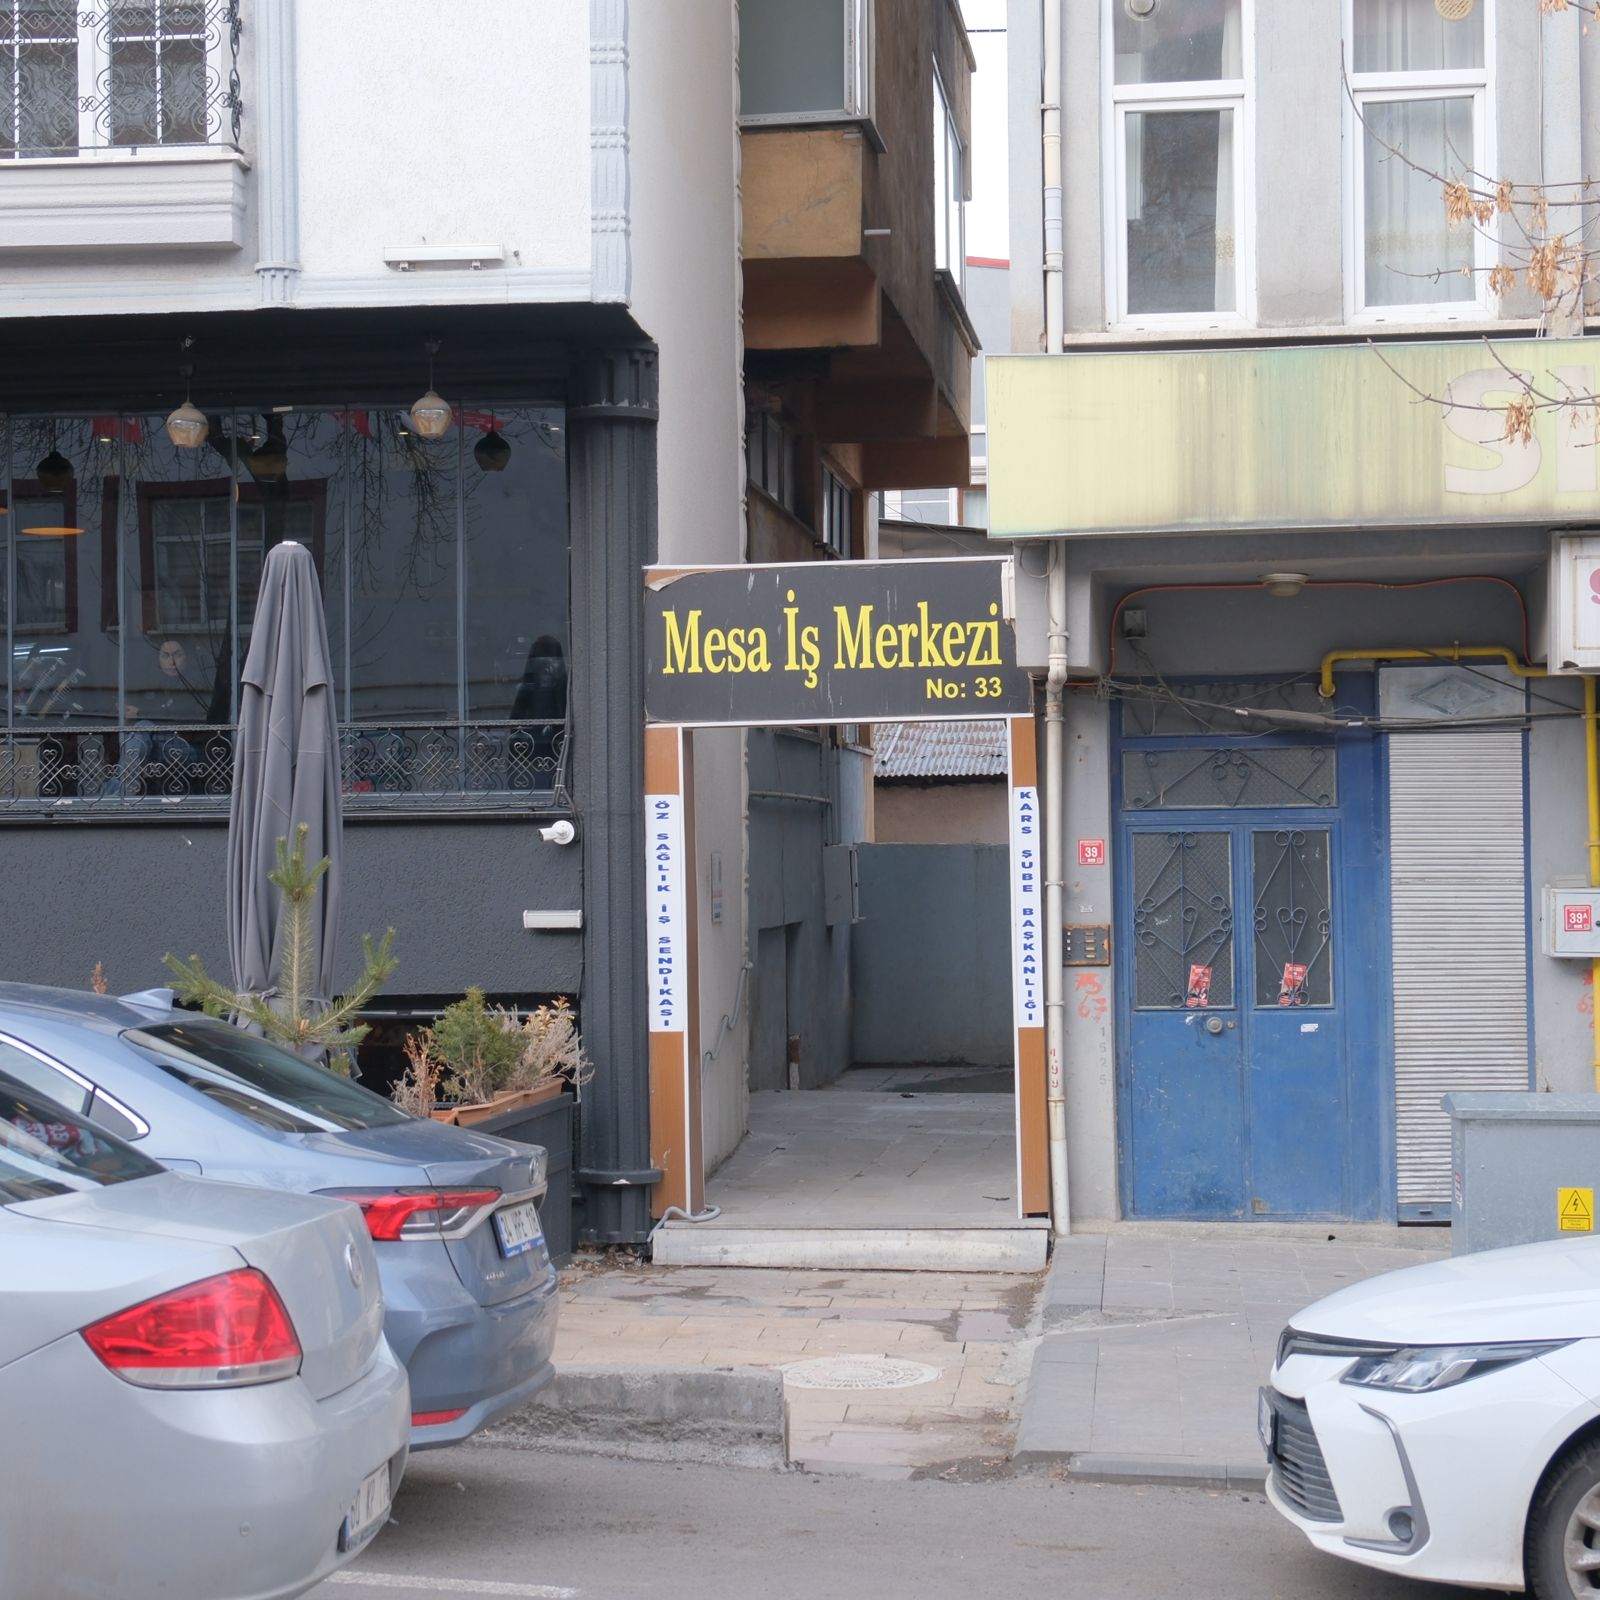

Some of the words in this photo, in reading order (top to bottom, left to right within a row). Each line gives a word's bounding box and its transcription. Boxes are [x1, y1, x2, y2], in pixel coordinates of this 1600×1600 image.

[661, 609, 772, 675] Mesa
[783, 589, 820, 689] İş
[833, 601, 1003, 671] Merkezi
[926, 678, 966, 699] No:
[974, 677, 1003, 699] 33
[655, 800, 670, 820] ÖZ
[1020, 791, 1033, 835] KARS
[656, 833, 671, 892] SAĞLIK
[1021, 850, 1034, 893] ŞUBE
[1084, 846, 1098, 858] 39
[1022, 907, 1037, 1021] BAŞKANLIĞI
